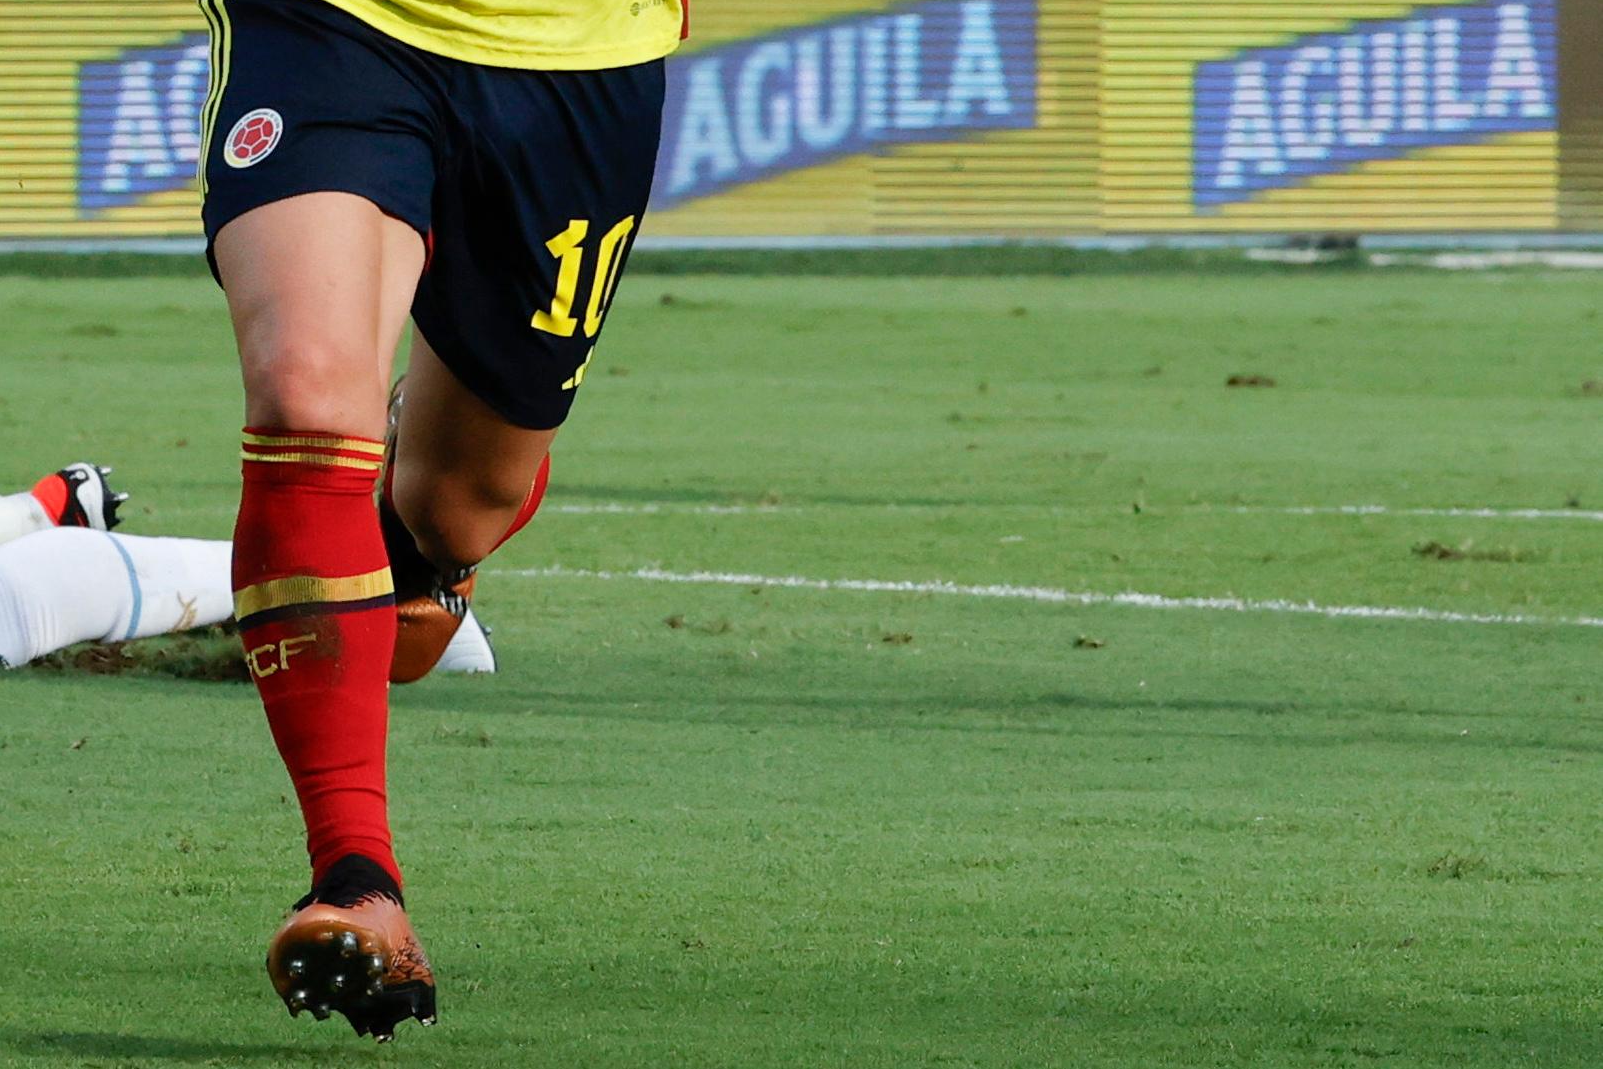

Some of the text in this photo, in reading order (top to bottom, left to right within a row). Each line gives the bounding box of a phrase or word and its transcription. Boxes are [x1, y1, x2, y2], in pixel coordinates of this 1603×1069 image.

[666, 0, 1014, 196] AGUILA
[1214, 3, 1555, 188] AGUILA
[530, 214, 635, 339] 10
[245, 633, 317, 678] CF
